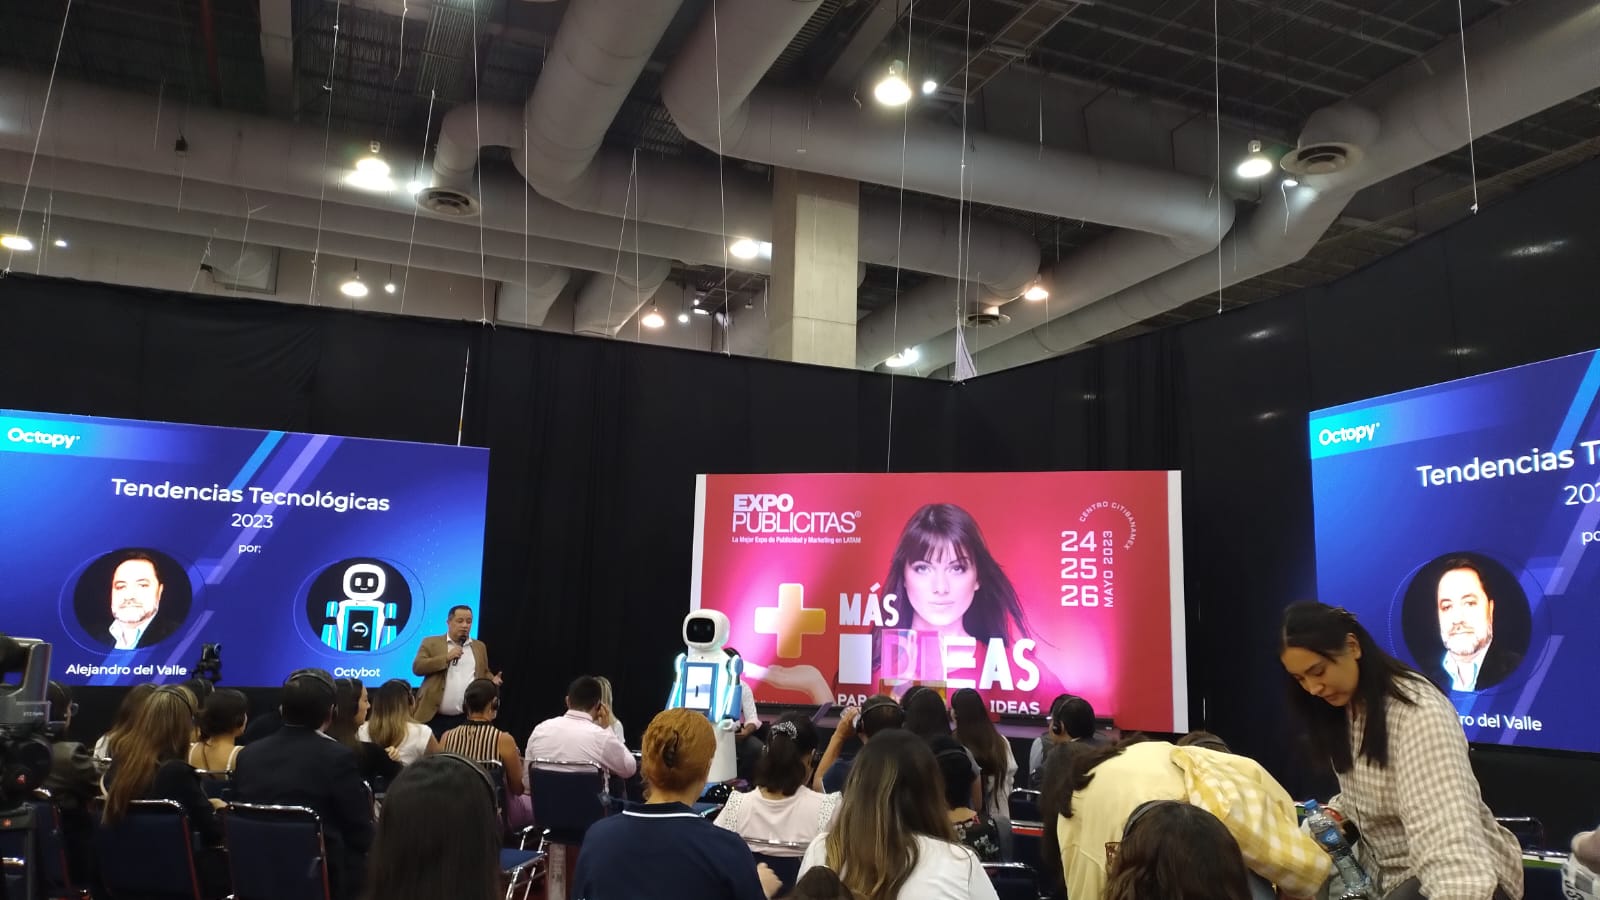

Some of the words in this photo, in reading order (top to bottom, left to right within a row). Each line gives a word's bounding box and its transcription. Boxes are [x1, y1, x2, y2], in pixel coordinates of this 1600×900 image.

[7, 427, 75, 449] Octopy
[1416, 447, 1575, 487] Tendencias
[111, 478, 243, 503] Tendencias
[249, 487, 390, 512] Tecnológicas
[733, 493, 793, 512] EXPO
[231, 513, 274, 529] 2023
[1079, 501, 1109, 522] CENTRO
[1111, 502, 1136, 550] CITIBANAMEX
[238, 544, 262, 554] por:
[1061, 530, 1097, 552] 24
[1103, 530, 1113, 565] 2023
[1061, 557, 1097, 579] 25
[1061, 584, 1099, 607] 26
[1103, 570, 1113, 608] MAYO
[839, 582, 900, 627] MÁS
[66, 664, 131, 676] Alejandro
[133, 665, 153, 675] del
[157, 665, 187, 675] Valle
[334, 667, 381, 679] Octybot
[990, 700, 1041, 715] IDEAS
[1477, 713, 1500, 728] del
[1503, 715, 1542, 731] Valle
